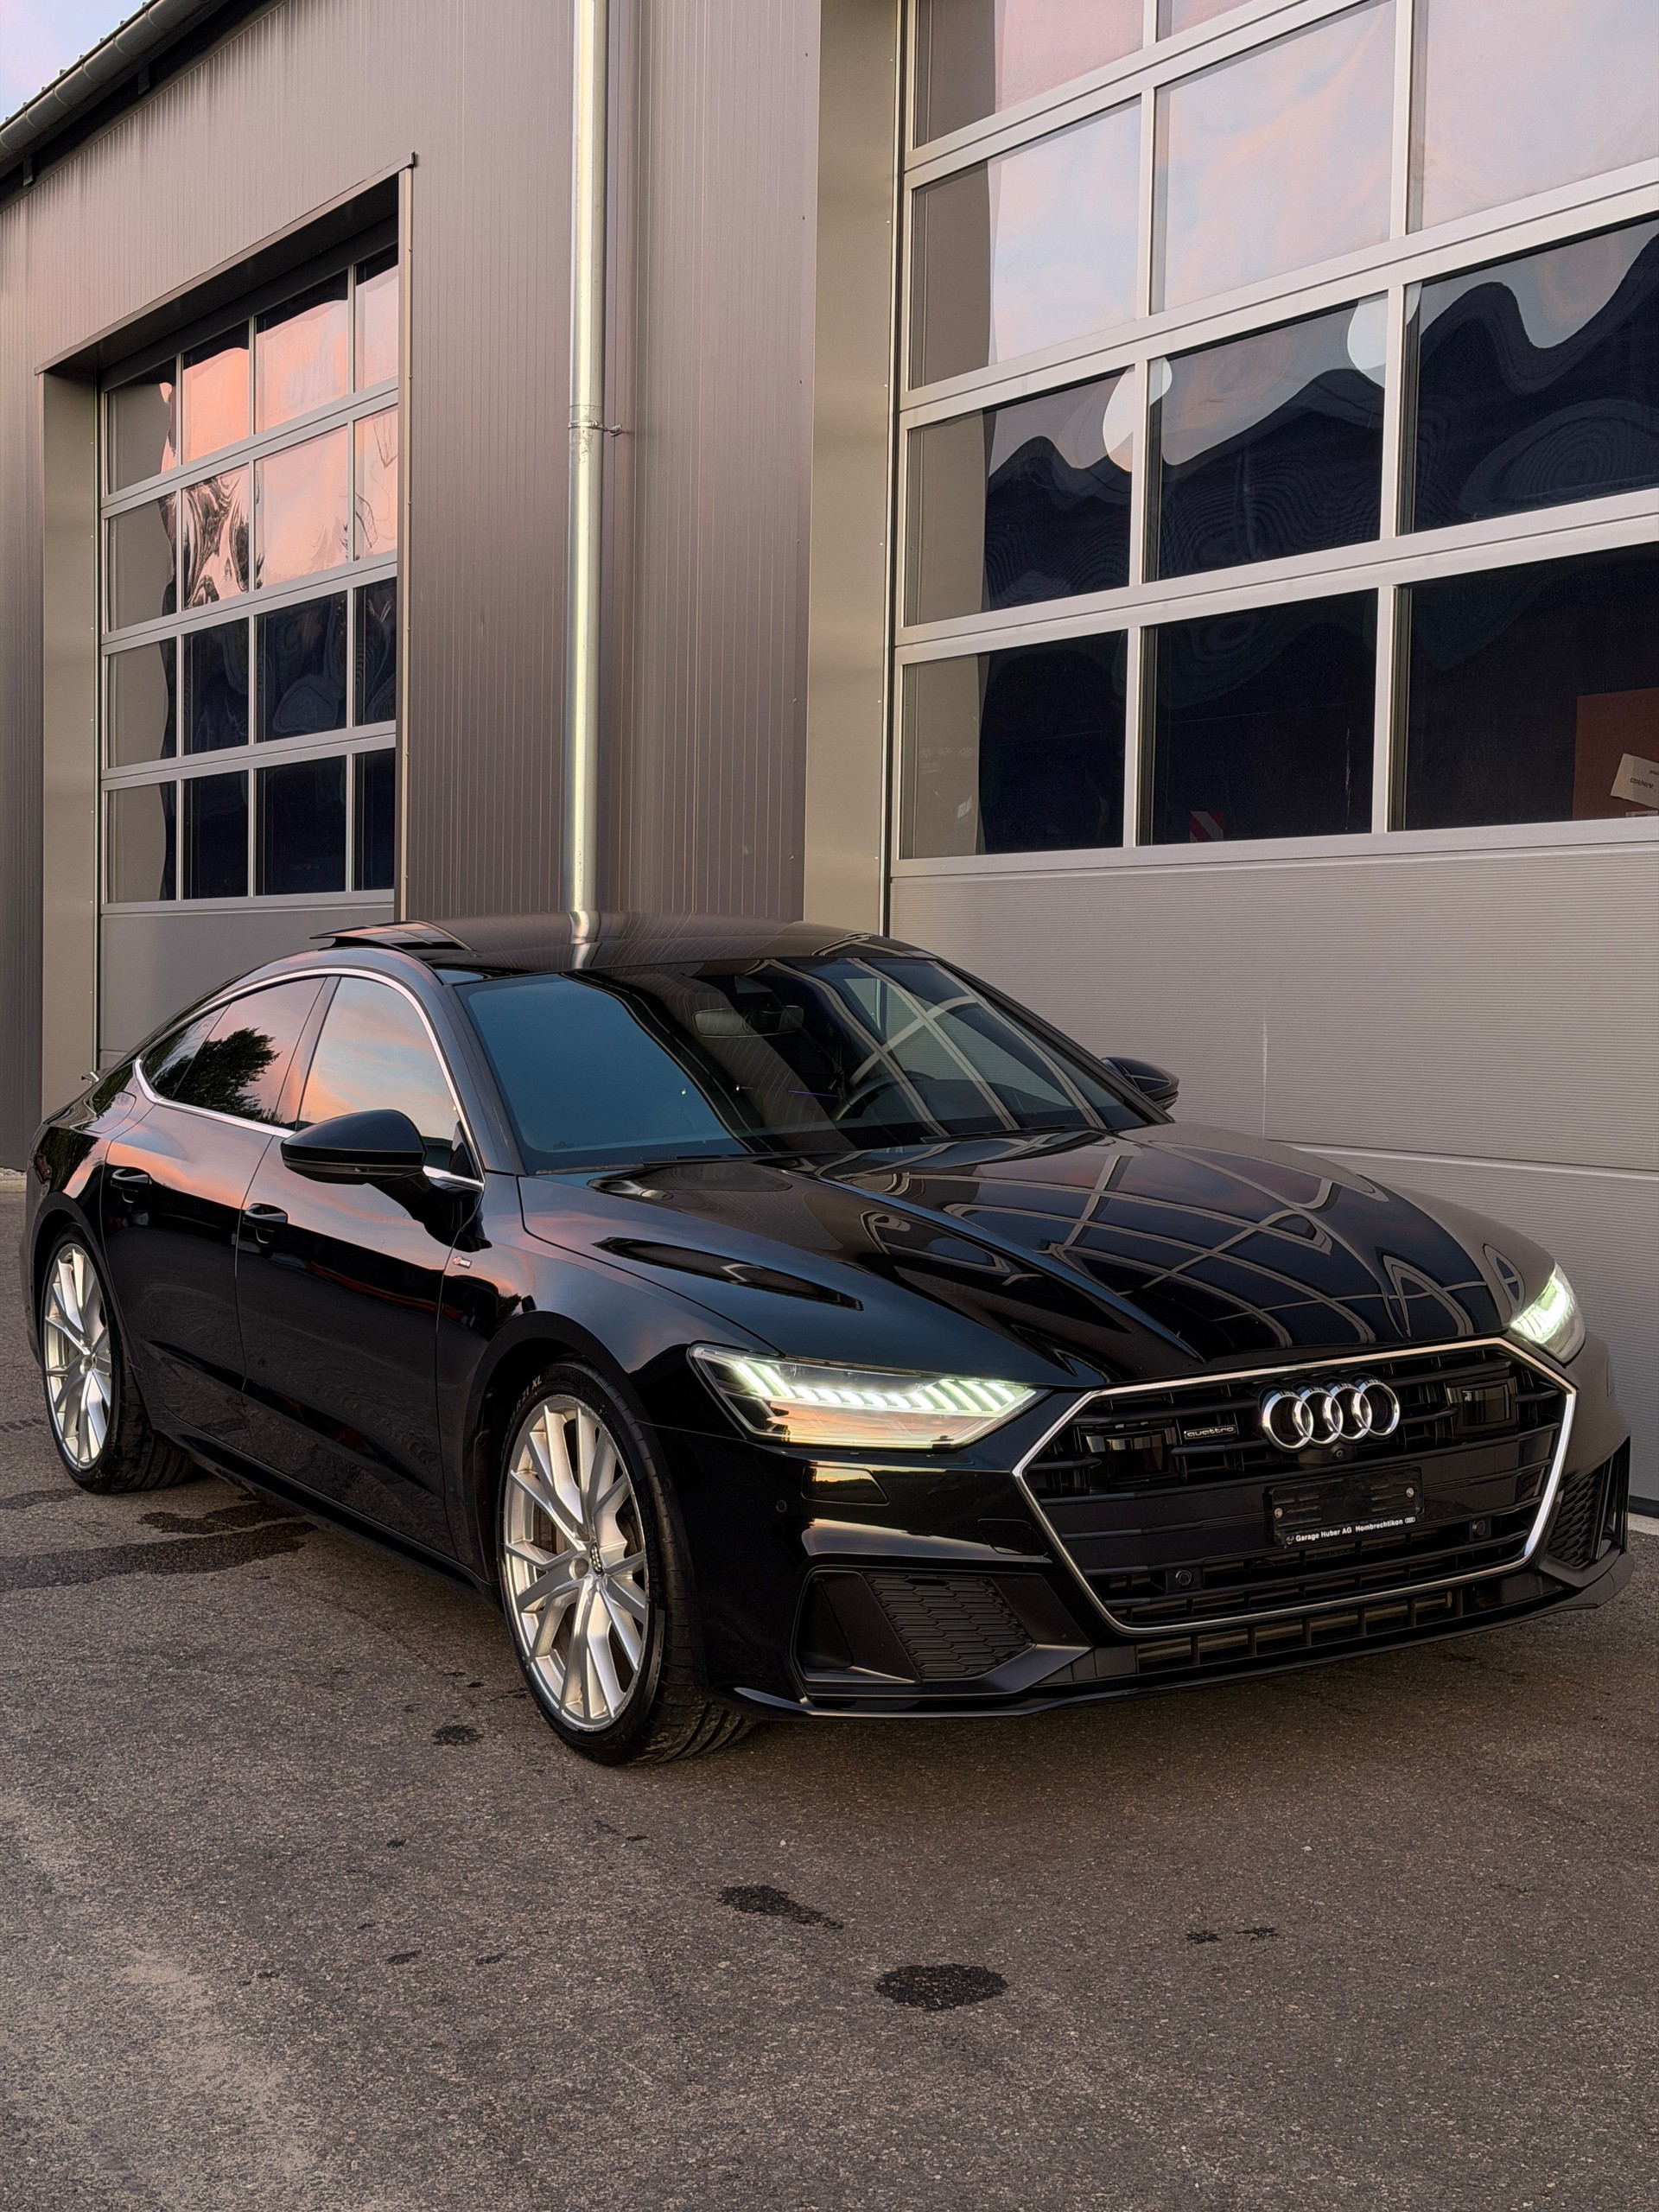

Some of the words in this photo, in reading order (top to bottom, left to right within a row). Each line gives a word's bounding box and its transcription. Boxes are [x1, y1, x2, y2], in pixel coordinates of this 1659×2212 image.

[1186, 1427, 1234, 1437] quattro
[1295, 1534, 1319, 1542] Garage
[1320, 1529, 1340, 1538] Huber
[1355, 1519, 1403, 1532] Hombrechtikon
